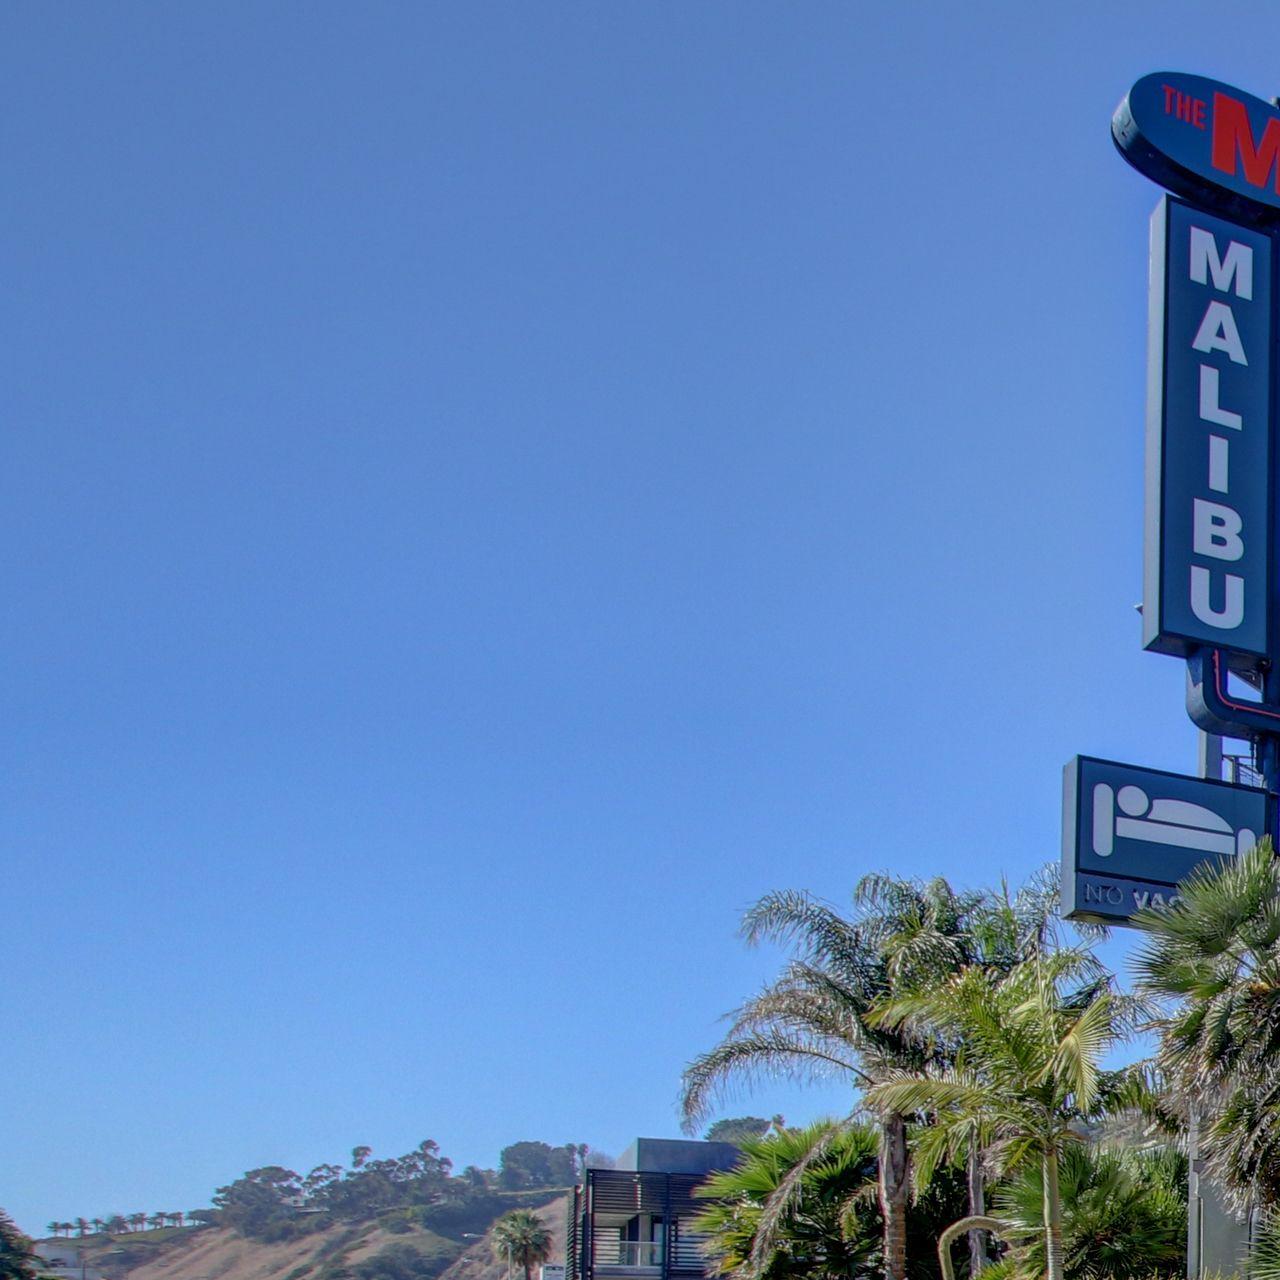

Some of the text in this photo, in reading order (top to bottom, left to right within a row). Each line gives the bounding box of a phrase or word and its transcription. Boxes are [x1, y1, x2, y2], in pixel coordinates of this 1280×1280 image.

[1162, 84, 1207, 131] THE
[1189, 226, 1253, 630] MALIBU
[1086, 884, 1124, 905] NO
